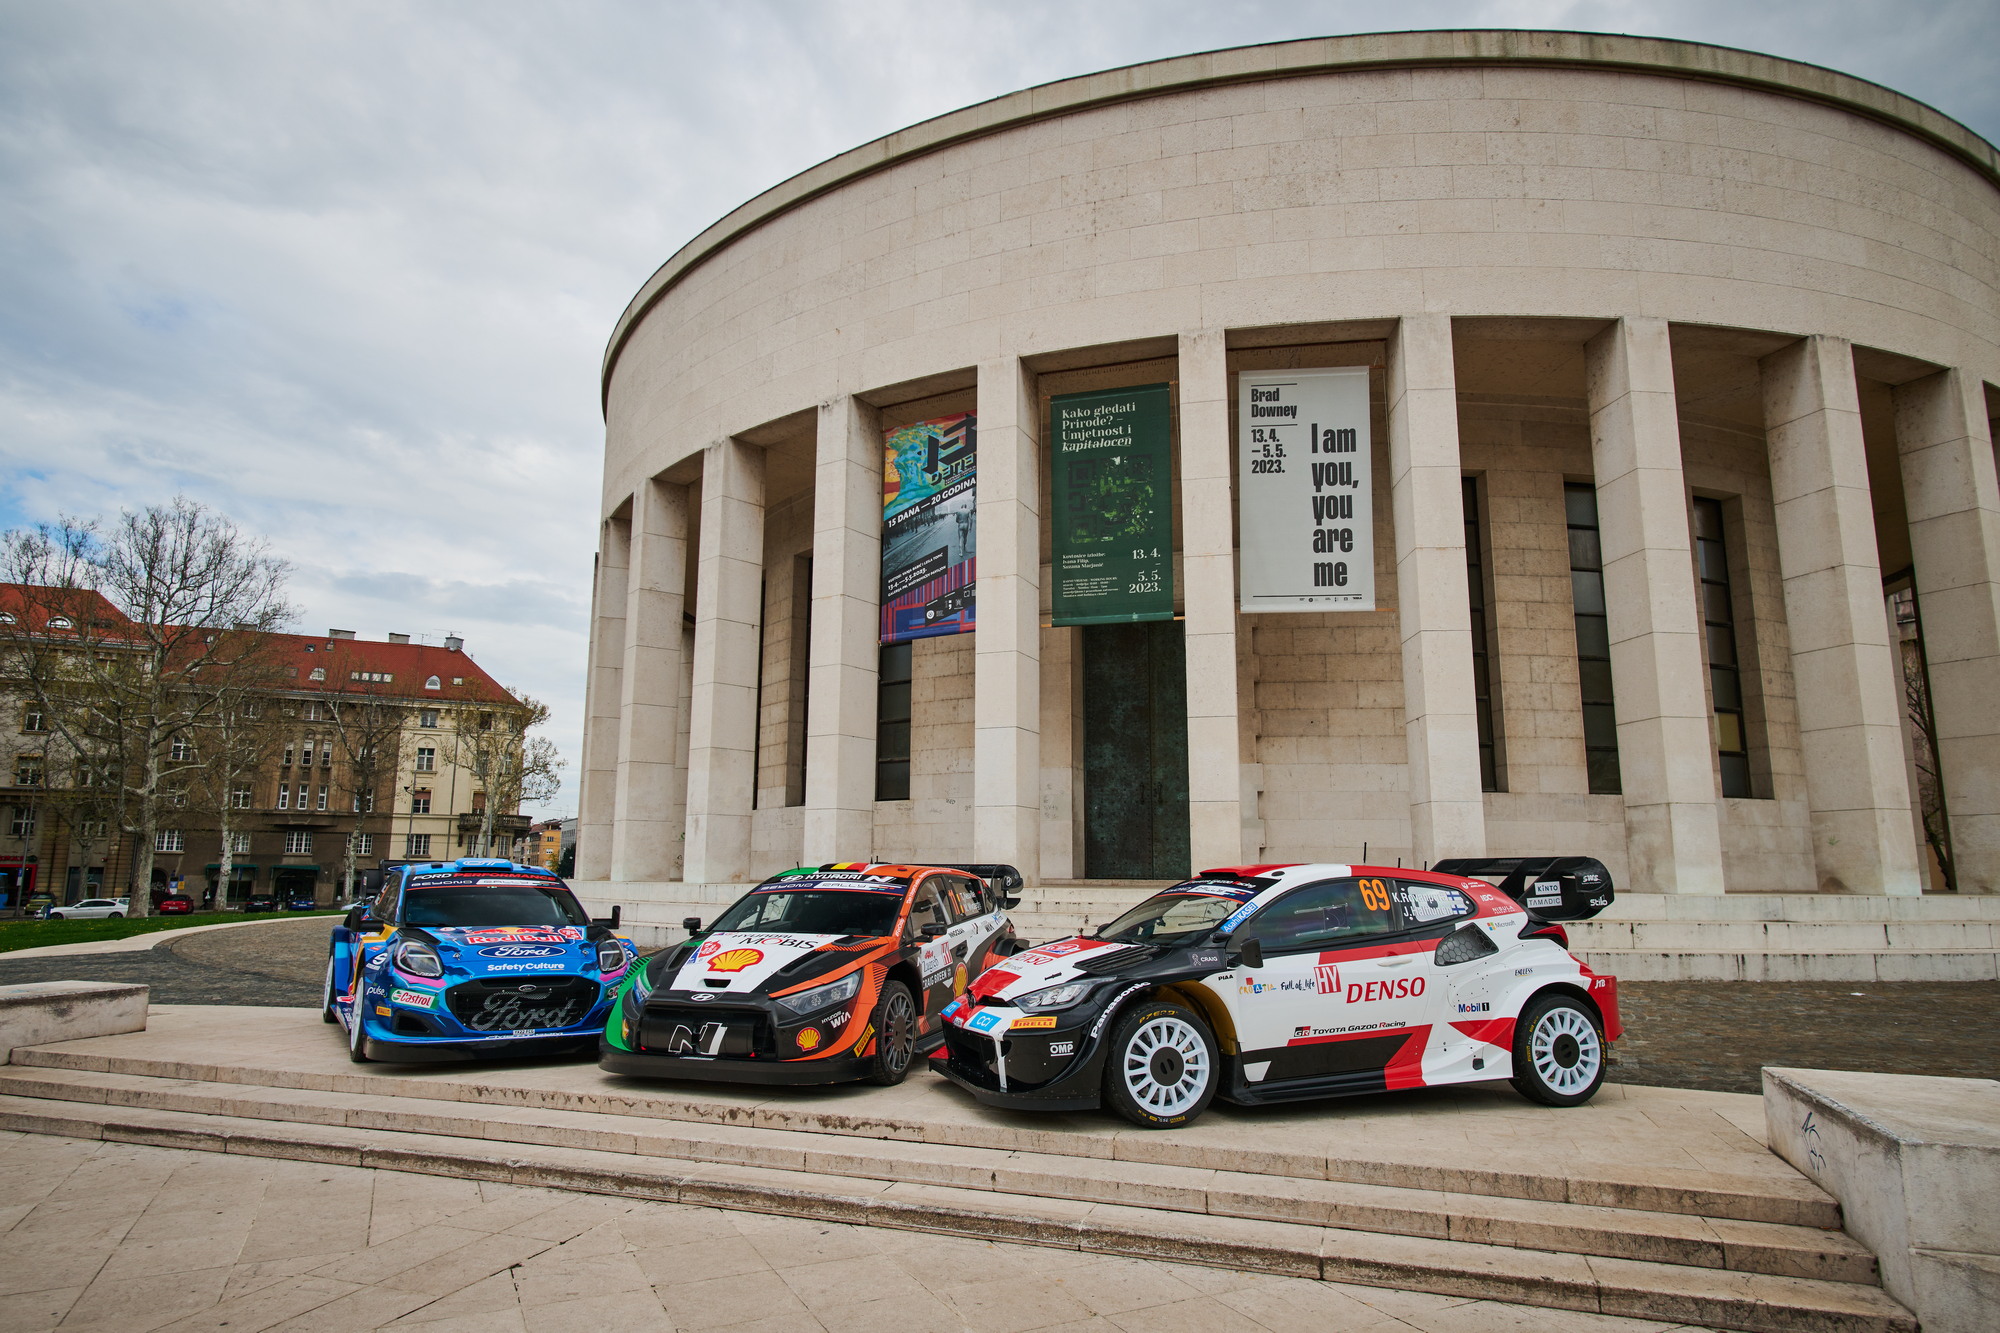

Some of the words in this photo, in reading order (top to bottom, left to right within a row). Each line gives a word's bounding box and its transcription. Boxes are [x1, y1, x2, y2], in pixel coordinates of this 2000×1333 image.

[1251, 388, 1280, 402] Brad
[1062, 408, 1091, 419] Kako
[1093, 402, 1136, 417] gledati
[1251, 403, 1298, 419] Downey
[1062, 415, 1114, 430] Prirode?
[1062, 426, 1125, 441] Umjetnost
[1127, 424, 1132, 434] i
[1311, 423, 1318, 454] I
[1322, 427, 1357, 453] am
[1062, 437, 1132, 453] kapitalocen
[1251, 459, 1286, 474] 2023.
[1311, 462, 1359, 492] you,
[888, 518, 897, 528] 15
[897, 505, 920, 524] DANA
[931, 494, 941, 506] 20
[941, 477, 976, 500] GODINA
[1311, 495, 1353, 526] you
[1313, 527, 1354, 553] are
[1132, 549, 1147, 560] 13.
[1150, 548, 1161, 558] 4.
[1138, 570, 1148, 582] 5.
[1151, 569, 1161, 581] 5.
[1314, 561, 1348, 587] me
[1129, 582, 1162, 594] 2023.
[413, 873, 452, 881] FORD
[453, 872, 557, 881] PERFORMANCE
[805, 873, 863, 881] HYUNDAI
[1358, 879, 1391, 911] 69
[1529, 897, 1561, 906] TAMADIC
[1223, 902, 1258, 932] AsahiKASEI
[1495, 920, 1516, 928] Microsoft
[468, 935, 516, 944] Red
[516, 934, 565, 944] Bull
[738, 937, 819, 949] MOBIS
[494, 945, 551, 957] Ford
[487, 962, 565, 972] SafetyCulture
[1514, 967, 1533, 976] ENDLESS
[366, 985, 385, 996] pulse
[1239, 983, 1277, 995] CROATIA
[1280, 980, 1294, 990] Full
[1346, 976, 1426, 1004] DENSO
[399, 992, 432, 1007] Castrol
[471, 990, 577, 1031] Ford
[1090, 981, 1152, 1039] Panasonic
[1458, 1003, 1481, 1013] Mobil
[821, 1010, 842, 1024] HYUNDAI
[829, 1011, 852, 1029] WIA
[1013, 1018, 1054, 1027] PIRELLI
[1378, 1020, 1406, 1029] Racing
[857, 1027, 873, 1055] PIRELLI
[1050, 1043, 1074, 1055] OMP
